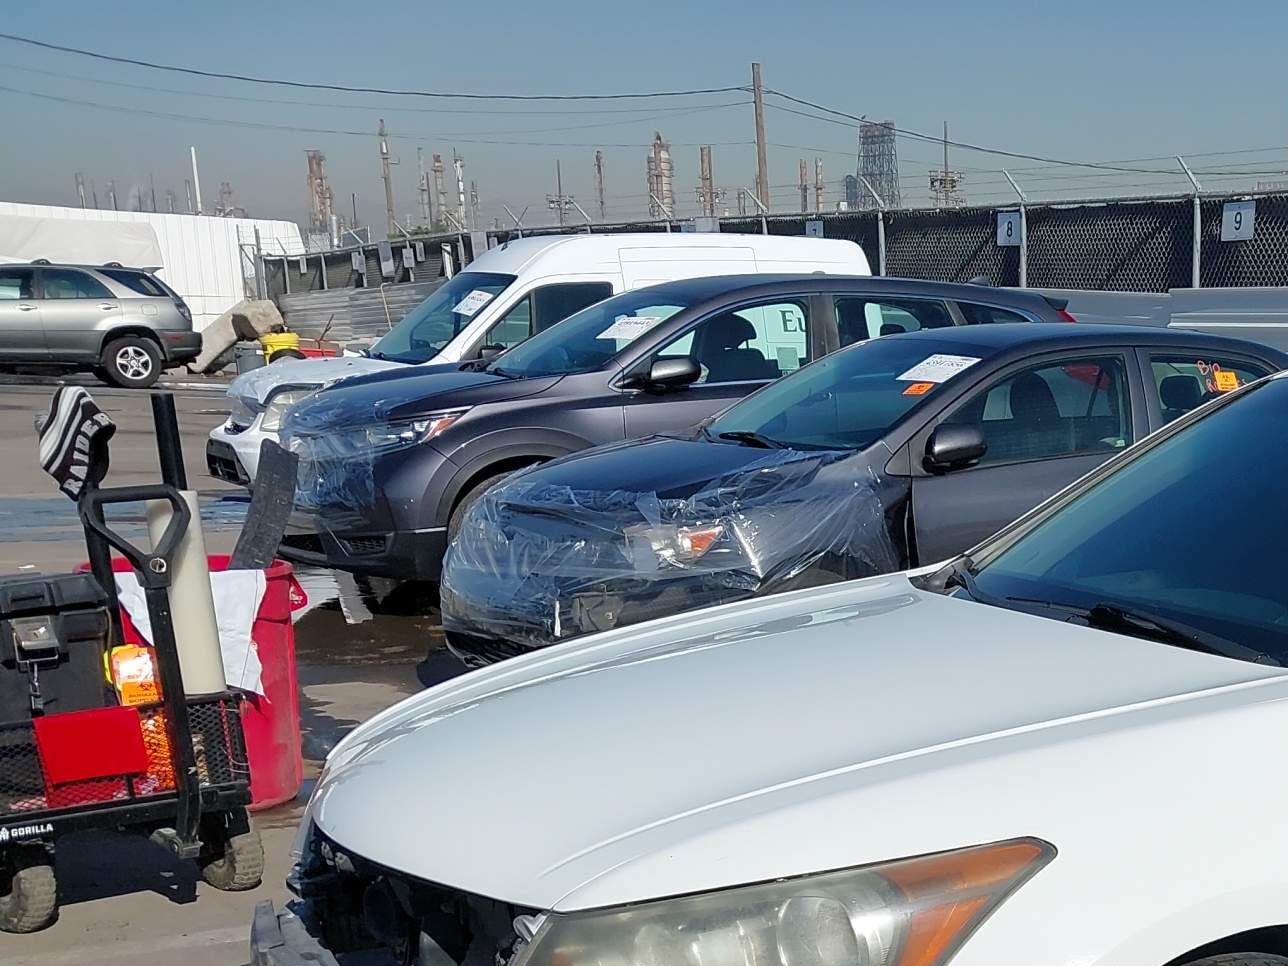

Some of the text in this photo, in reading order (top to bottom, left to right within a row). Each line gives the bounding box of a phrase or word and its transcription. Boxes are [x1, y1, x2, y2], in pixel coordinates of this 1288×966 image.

[1006, 221, 1013, 237] 8
[1233, 211, 1243, 231] 9
[10, 822, 54, 838] GORILLA
